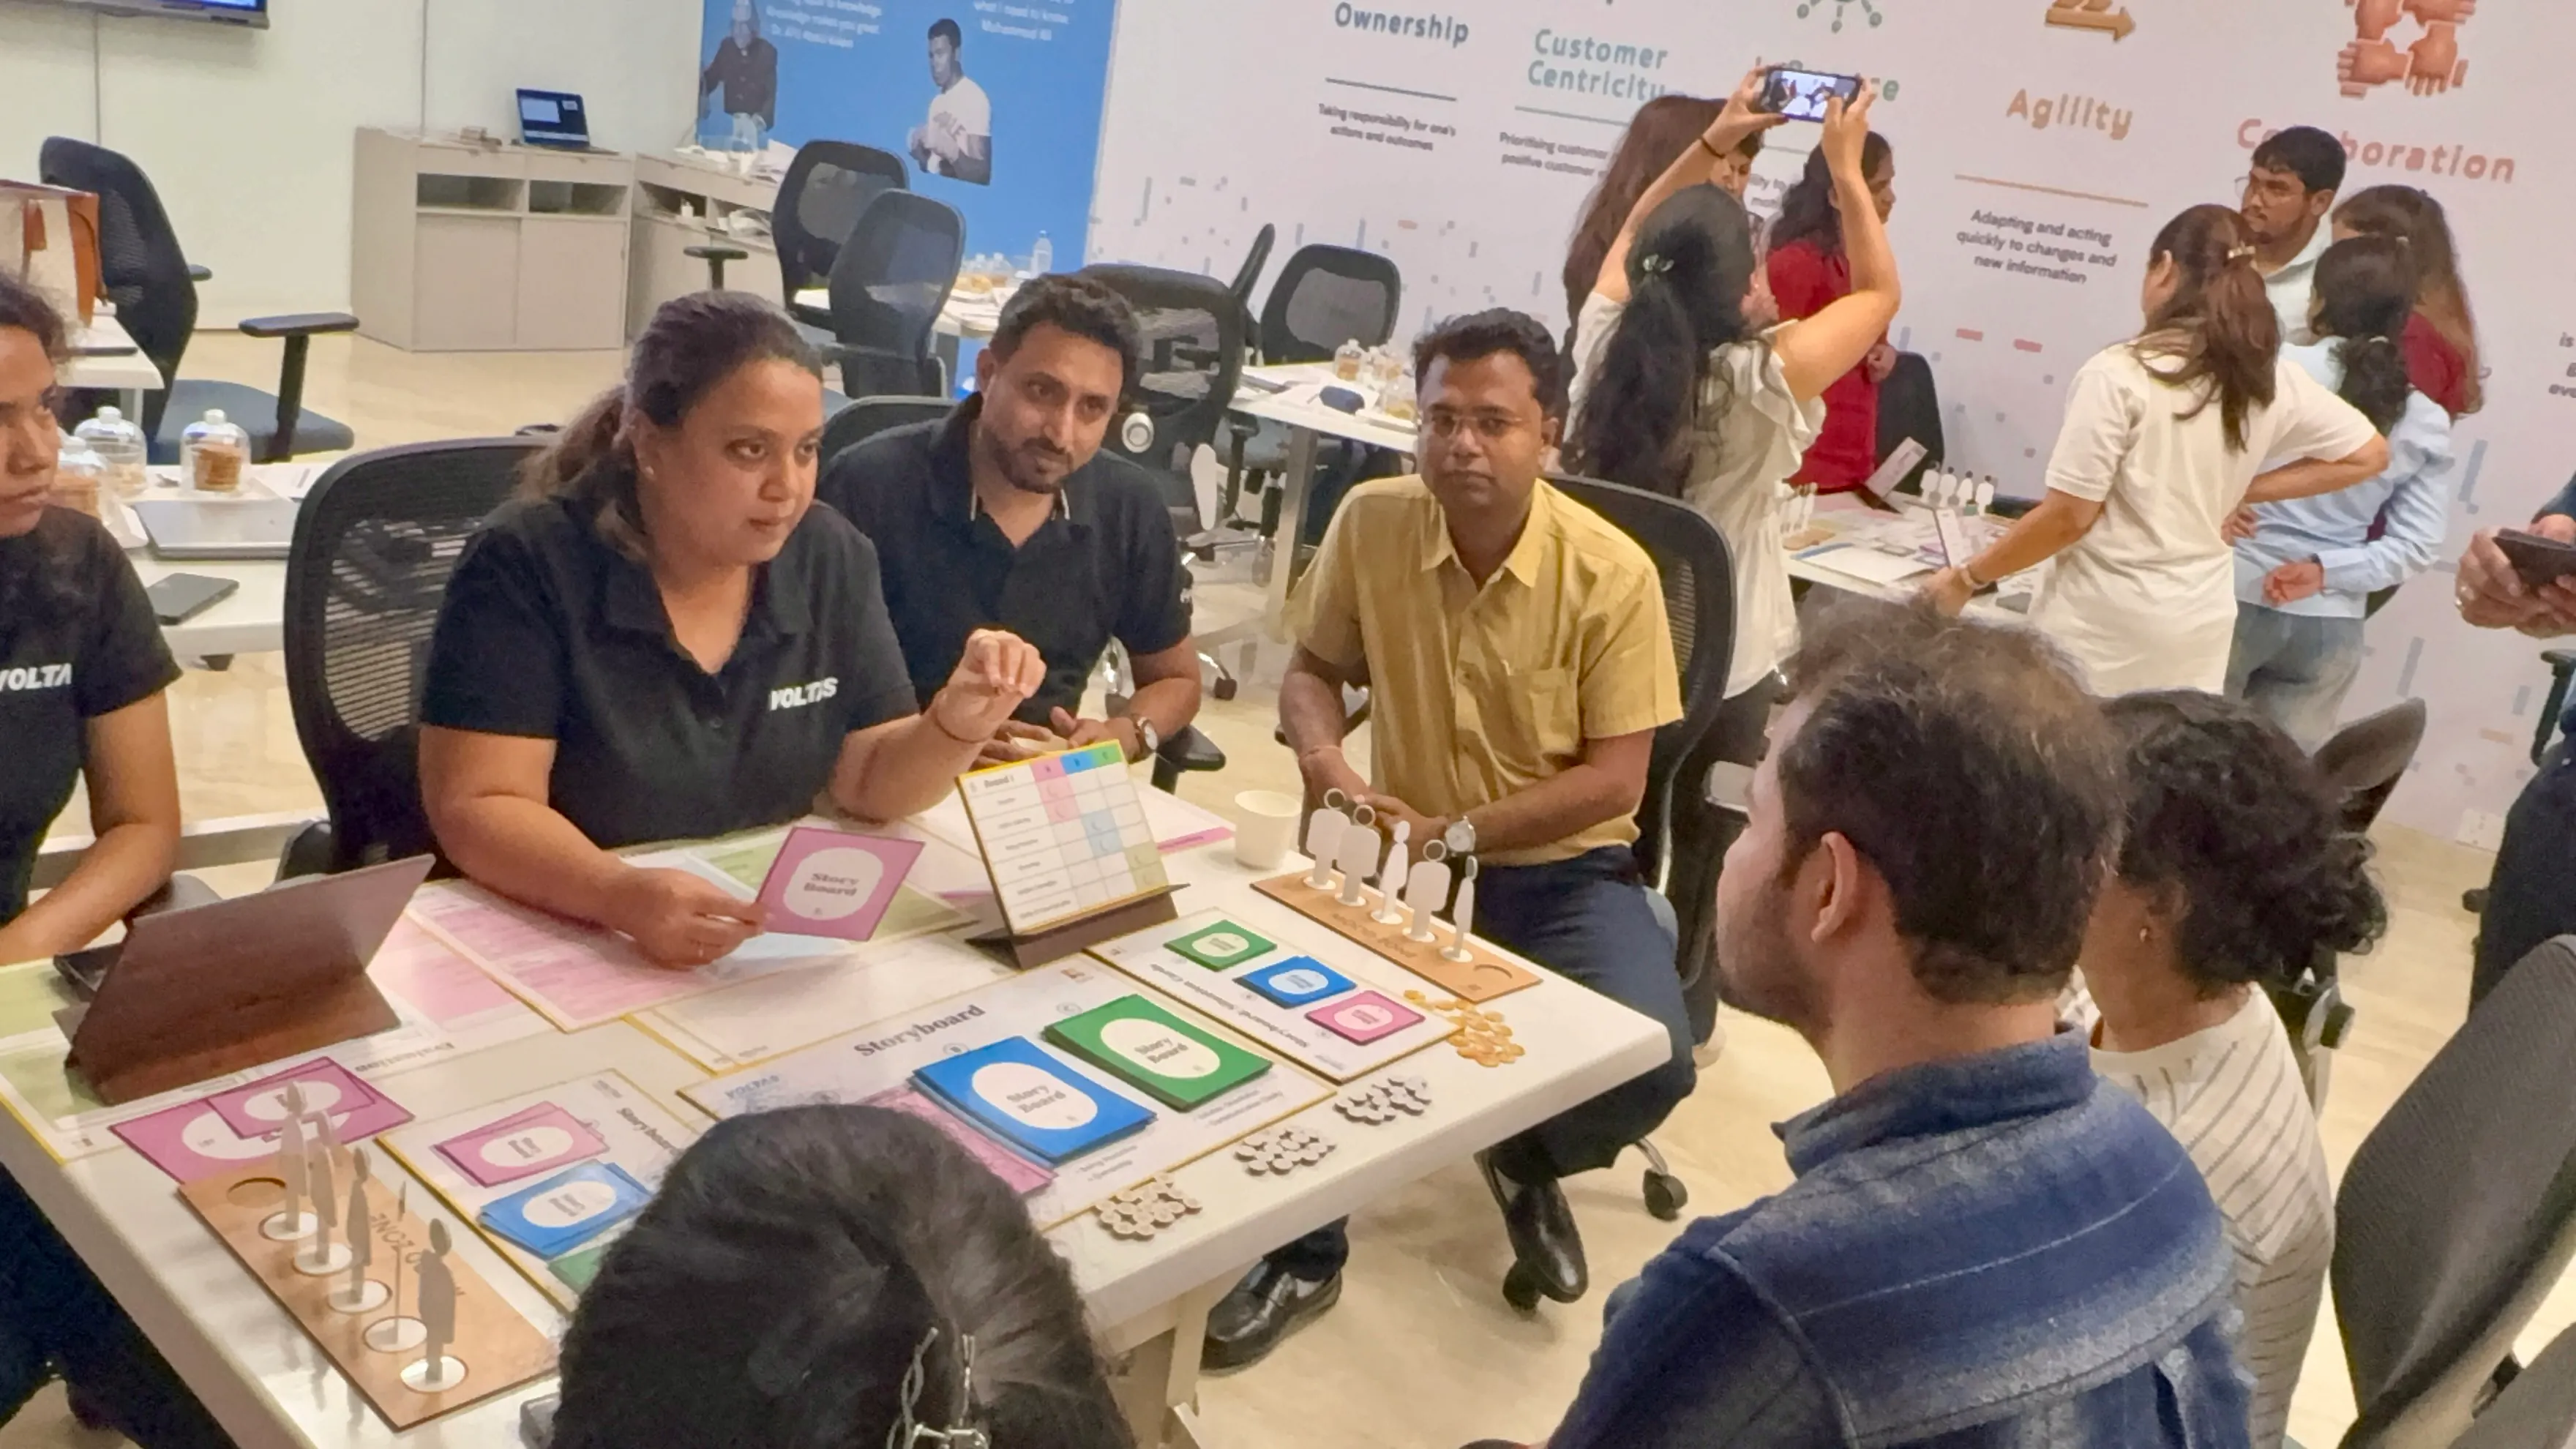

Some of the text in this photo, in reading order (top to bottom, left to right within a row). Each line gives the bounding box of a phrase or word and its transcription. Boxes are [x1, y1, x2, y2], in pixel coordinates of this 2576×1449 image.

[1335, 1, 1469, 49] Ownership
[1535, 29, 1669, 70] Customer
[2006, 88, 2133, 141] Agility
[2237, 118, 2515, 183] Cboration
[1970, 209, 2113, 248] Adapting and acting
[1956, 231, 2118, 267] quickly to changes and
[1974, 255, 2087, 284] new information
[804, 882, 858, 896] Board
[811, 873, 860, 887] Story
[854, 1004, 986, 1057] Storyboard
[1134, 1037, 1173, 1055] Story
[1147, 1042, 1189, 1064] Board
[1006, 1085, 1049, 1103] Story
[1017, 1090, 1066, 1113] Board
